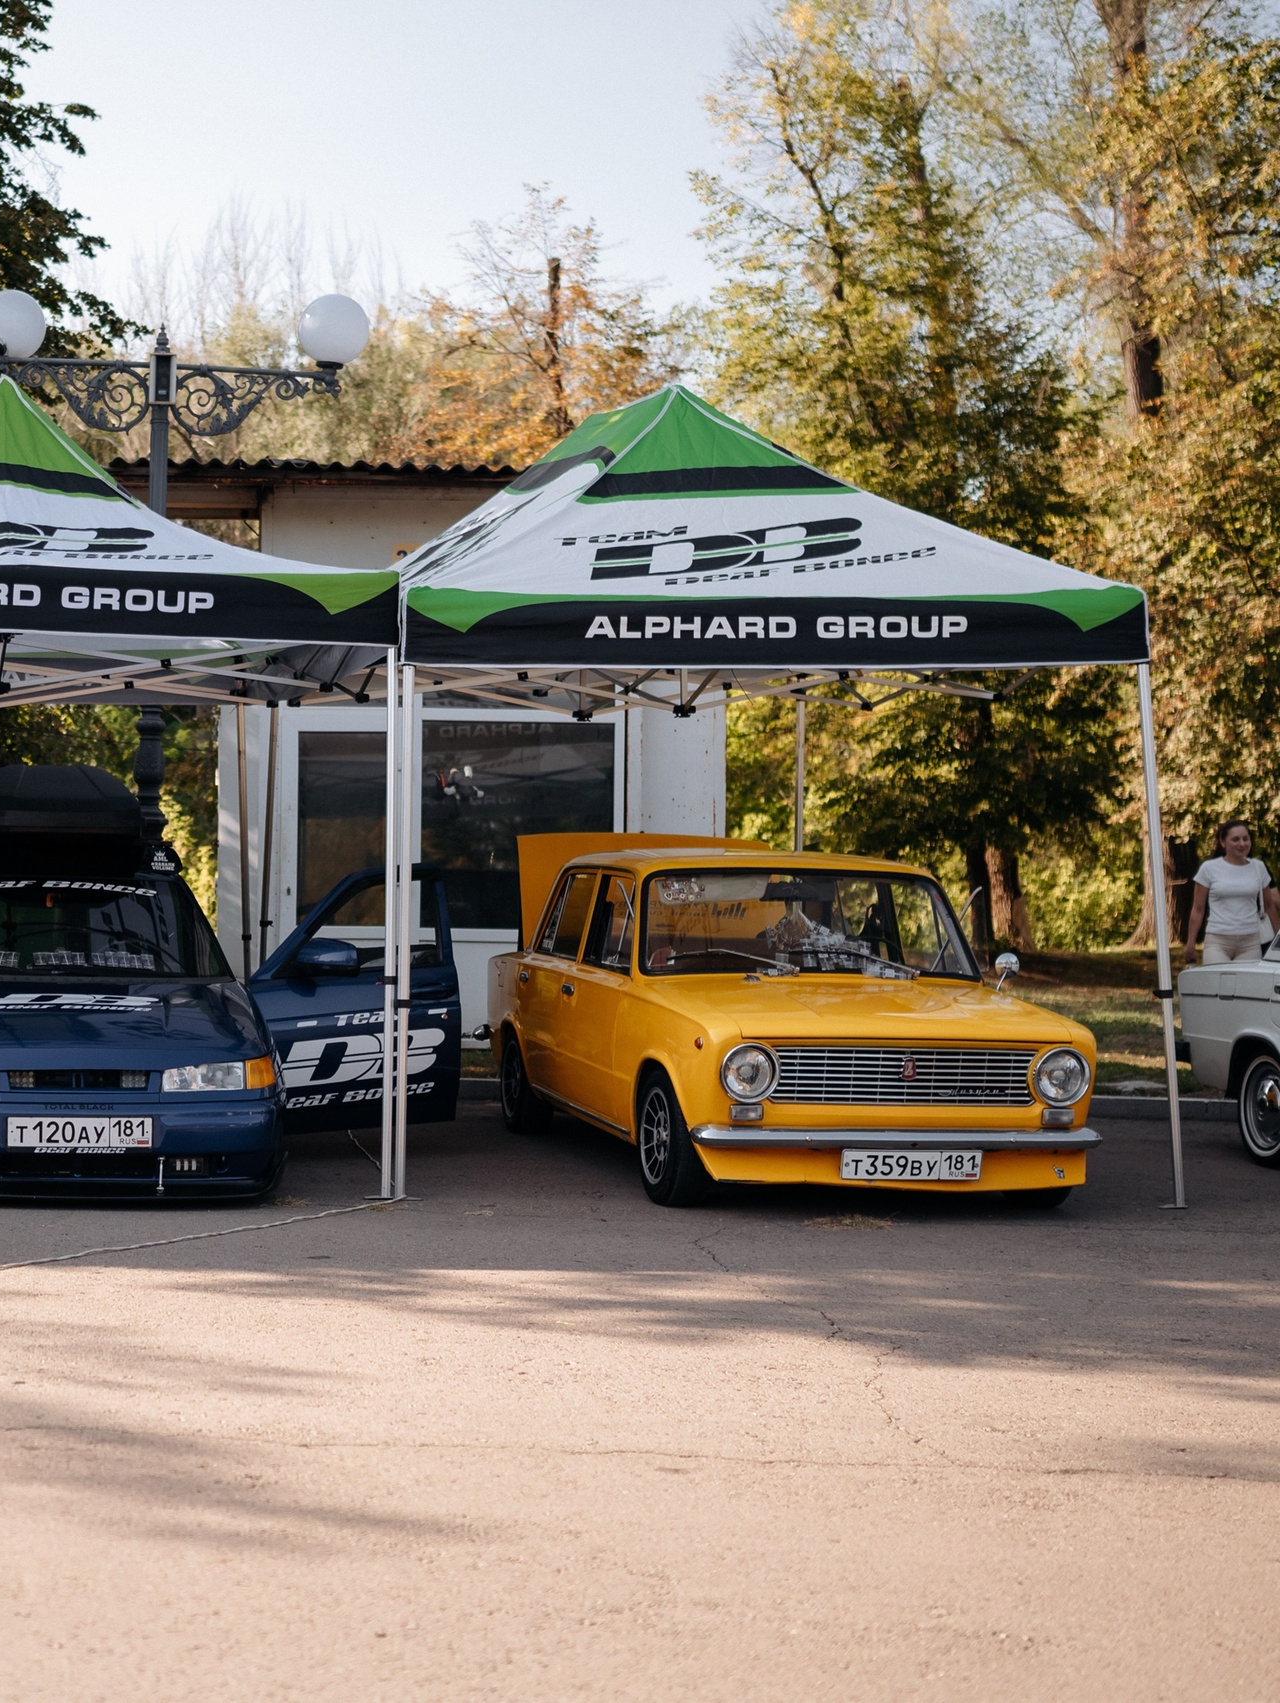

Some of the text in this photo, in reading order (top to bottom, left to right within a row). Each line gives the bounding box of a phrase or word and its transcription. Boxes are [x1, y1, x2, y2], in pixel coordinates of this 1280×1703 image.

[554, 525, 688, 547] Team
[590, 517, 863, 581] DB
[665, 546, 937, 586] Deaf Bonce
[61, 586, 214, 613] GROUP
[585, 616, 968, 638] ALPHARD GROUP
[42, 880, 158, 897] Bonce
[333, 1008, 411, 1027] Tea
[286, 1081, 435, 1110] eaf Boce
[44, 1103, 115, 1111] TOTAL BLACK
[16, 1120, 145, 1144] Т120АУ 181
[851, 1155, 977, 1177] Т359ВУ 181
